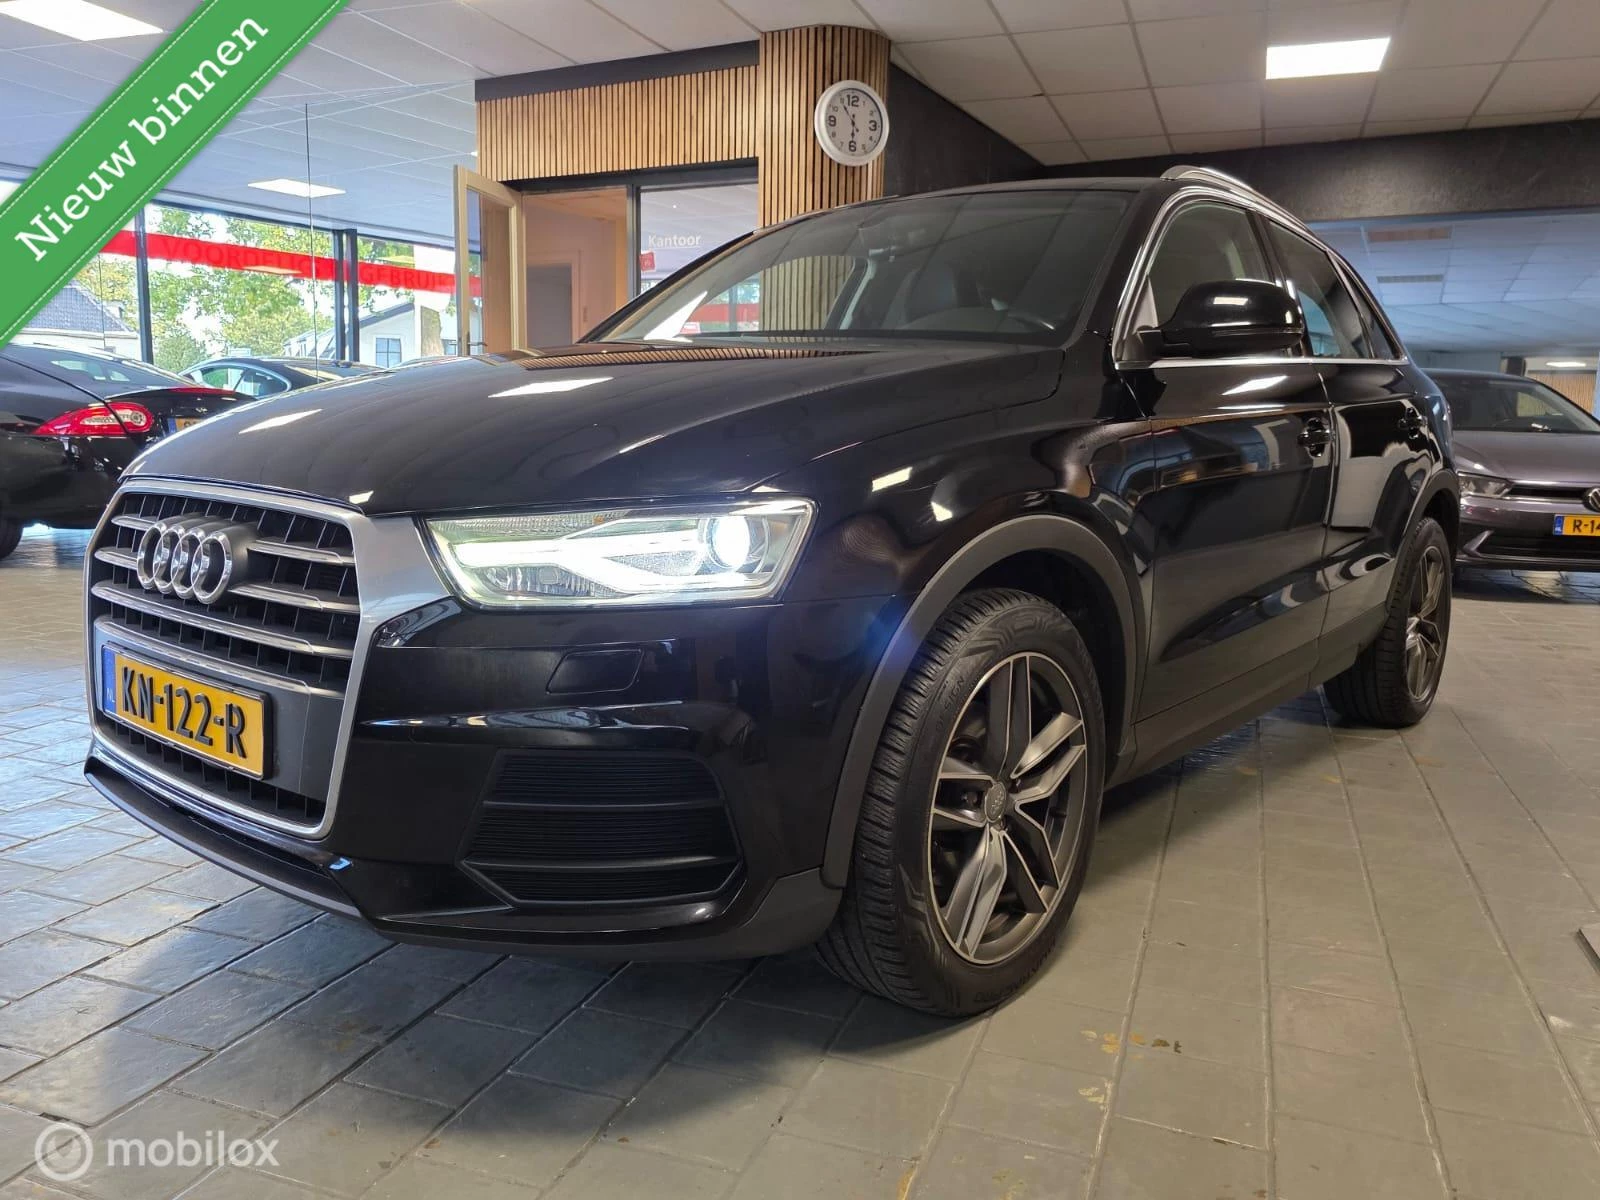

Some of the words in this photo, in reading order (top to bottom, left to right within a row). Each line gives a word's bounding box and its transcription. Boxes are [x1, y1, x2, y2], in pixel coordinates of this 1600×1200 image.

[846, 94, 860, 108] 12
[828, 115, 837, 127] 9
[868, 120, 877, 132] 3
[848, 140, 857, 153] 6
[648, 234, 702, 248] Kantoor
[122, 666, 248, 760] KN-122-R
